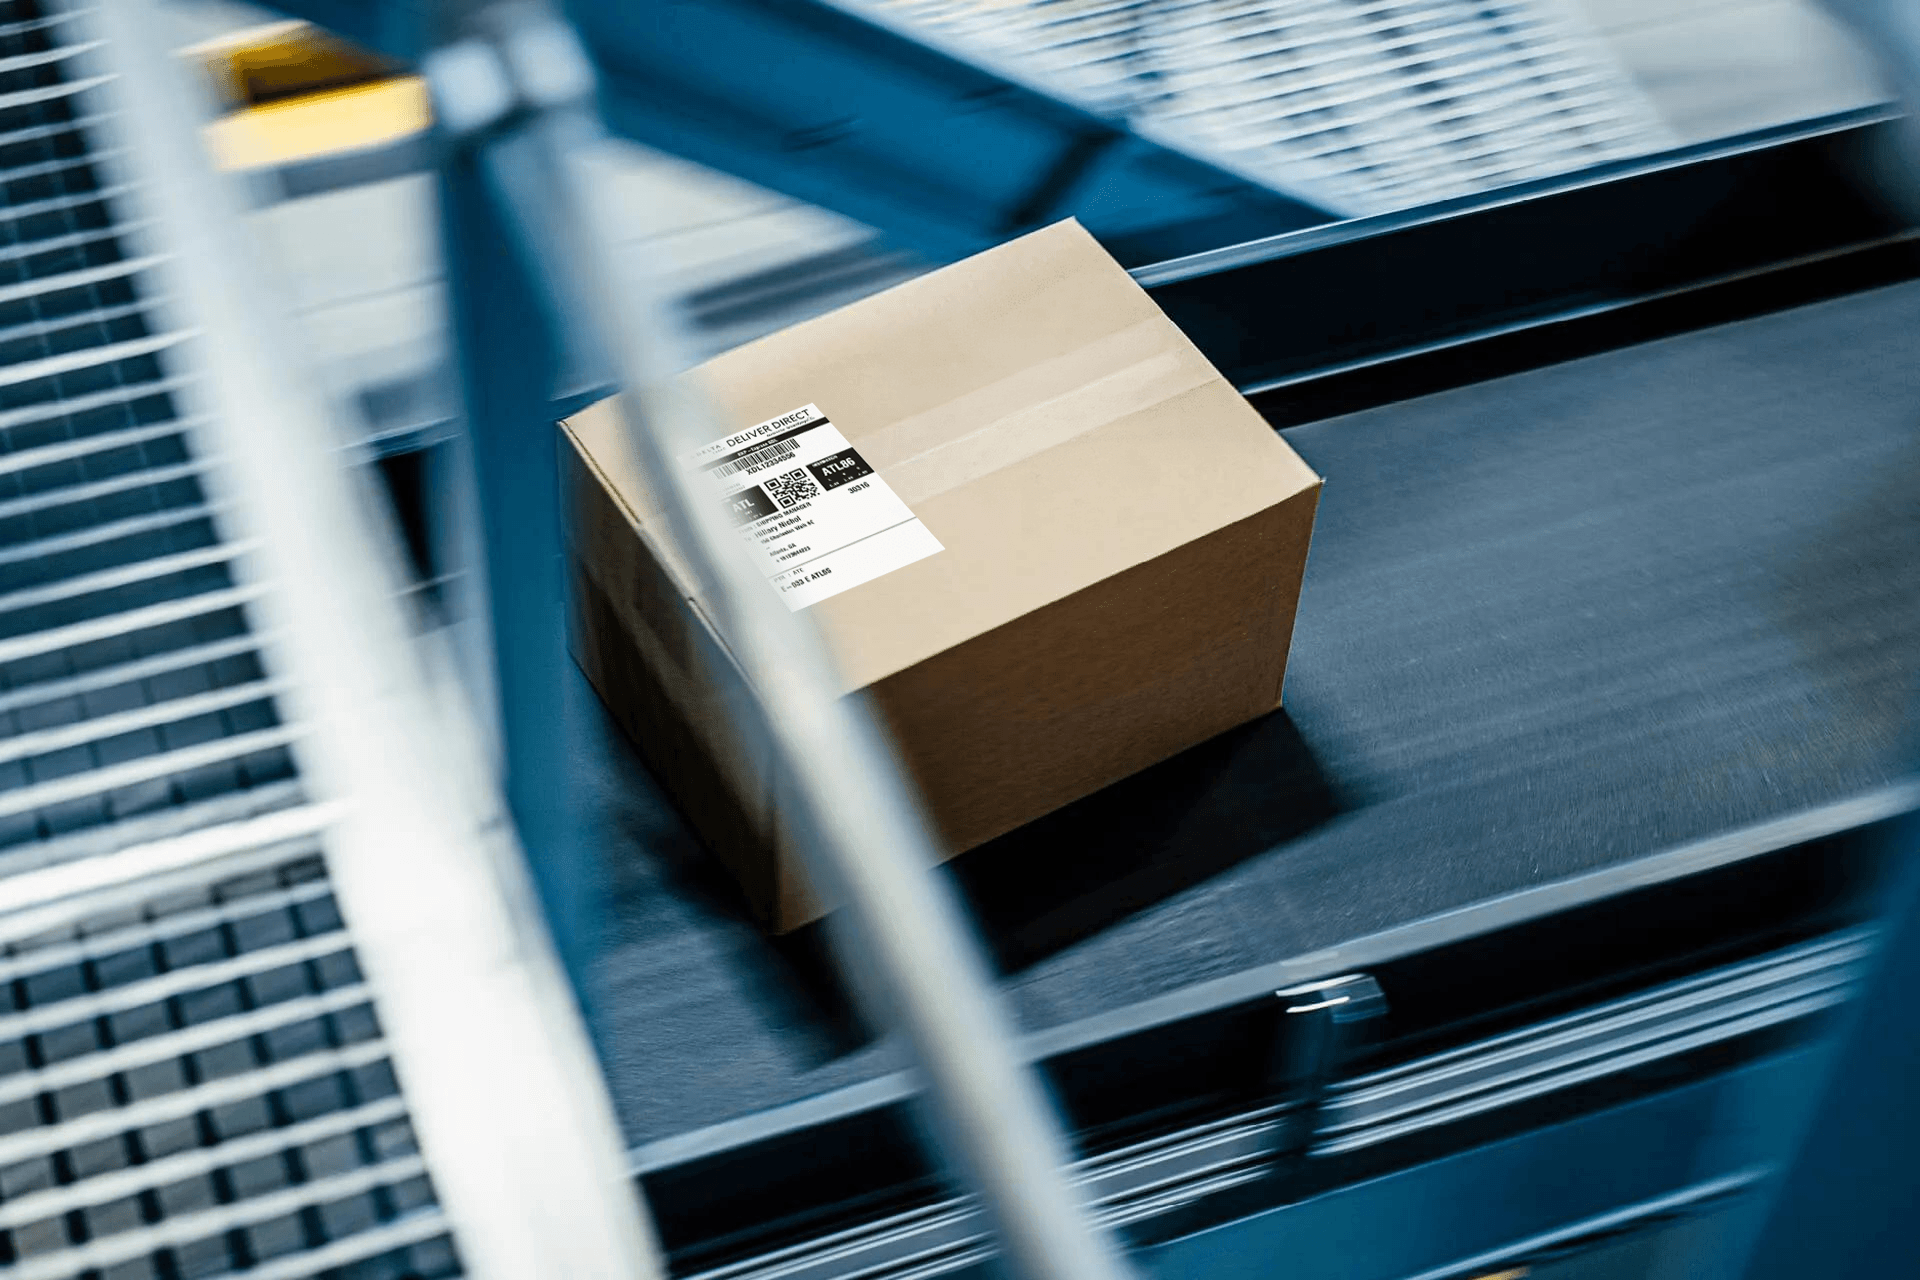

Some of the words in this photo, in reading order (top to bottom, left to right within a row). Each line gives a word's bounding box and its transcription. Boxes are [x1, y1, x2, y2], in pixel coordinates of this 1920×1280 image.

[726, 425, 772, 447] DELIVER
[771, 409, 809, 429] DIRECT
[822, 457, 855, 476] ATL86
[848, 482, 870, 494] 30316
[733, 499, 755, 513] ATL
[756, 513, 783, 527] SHIPPING
[783, 502, 812, 516] MANAGER
[754, 526, 778, 538] Hillary
[778, 515, 802, 528] Nichol
